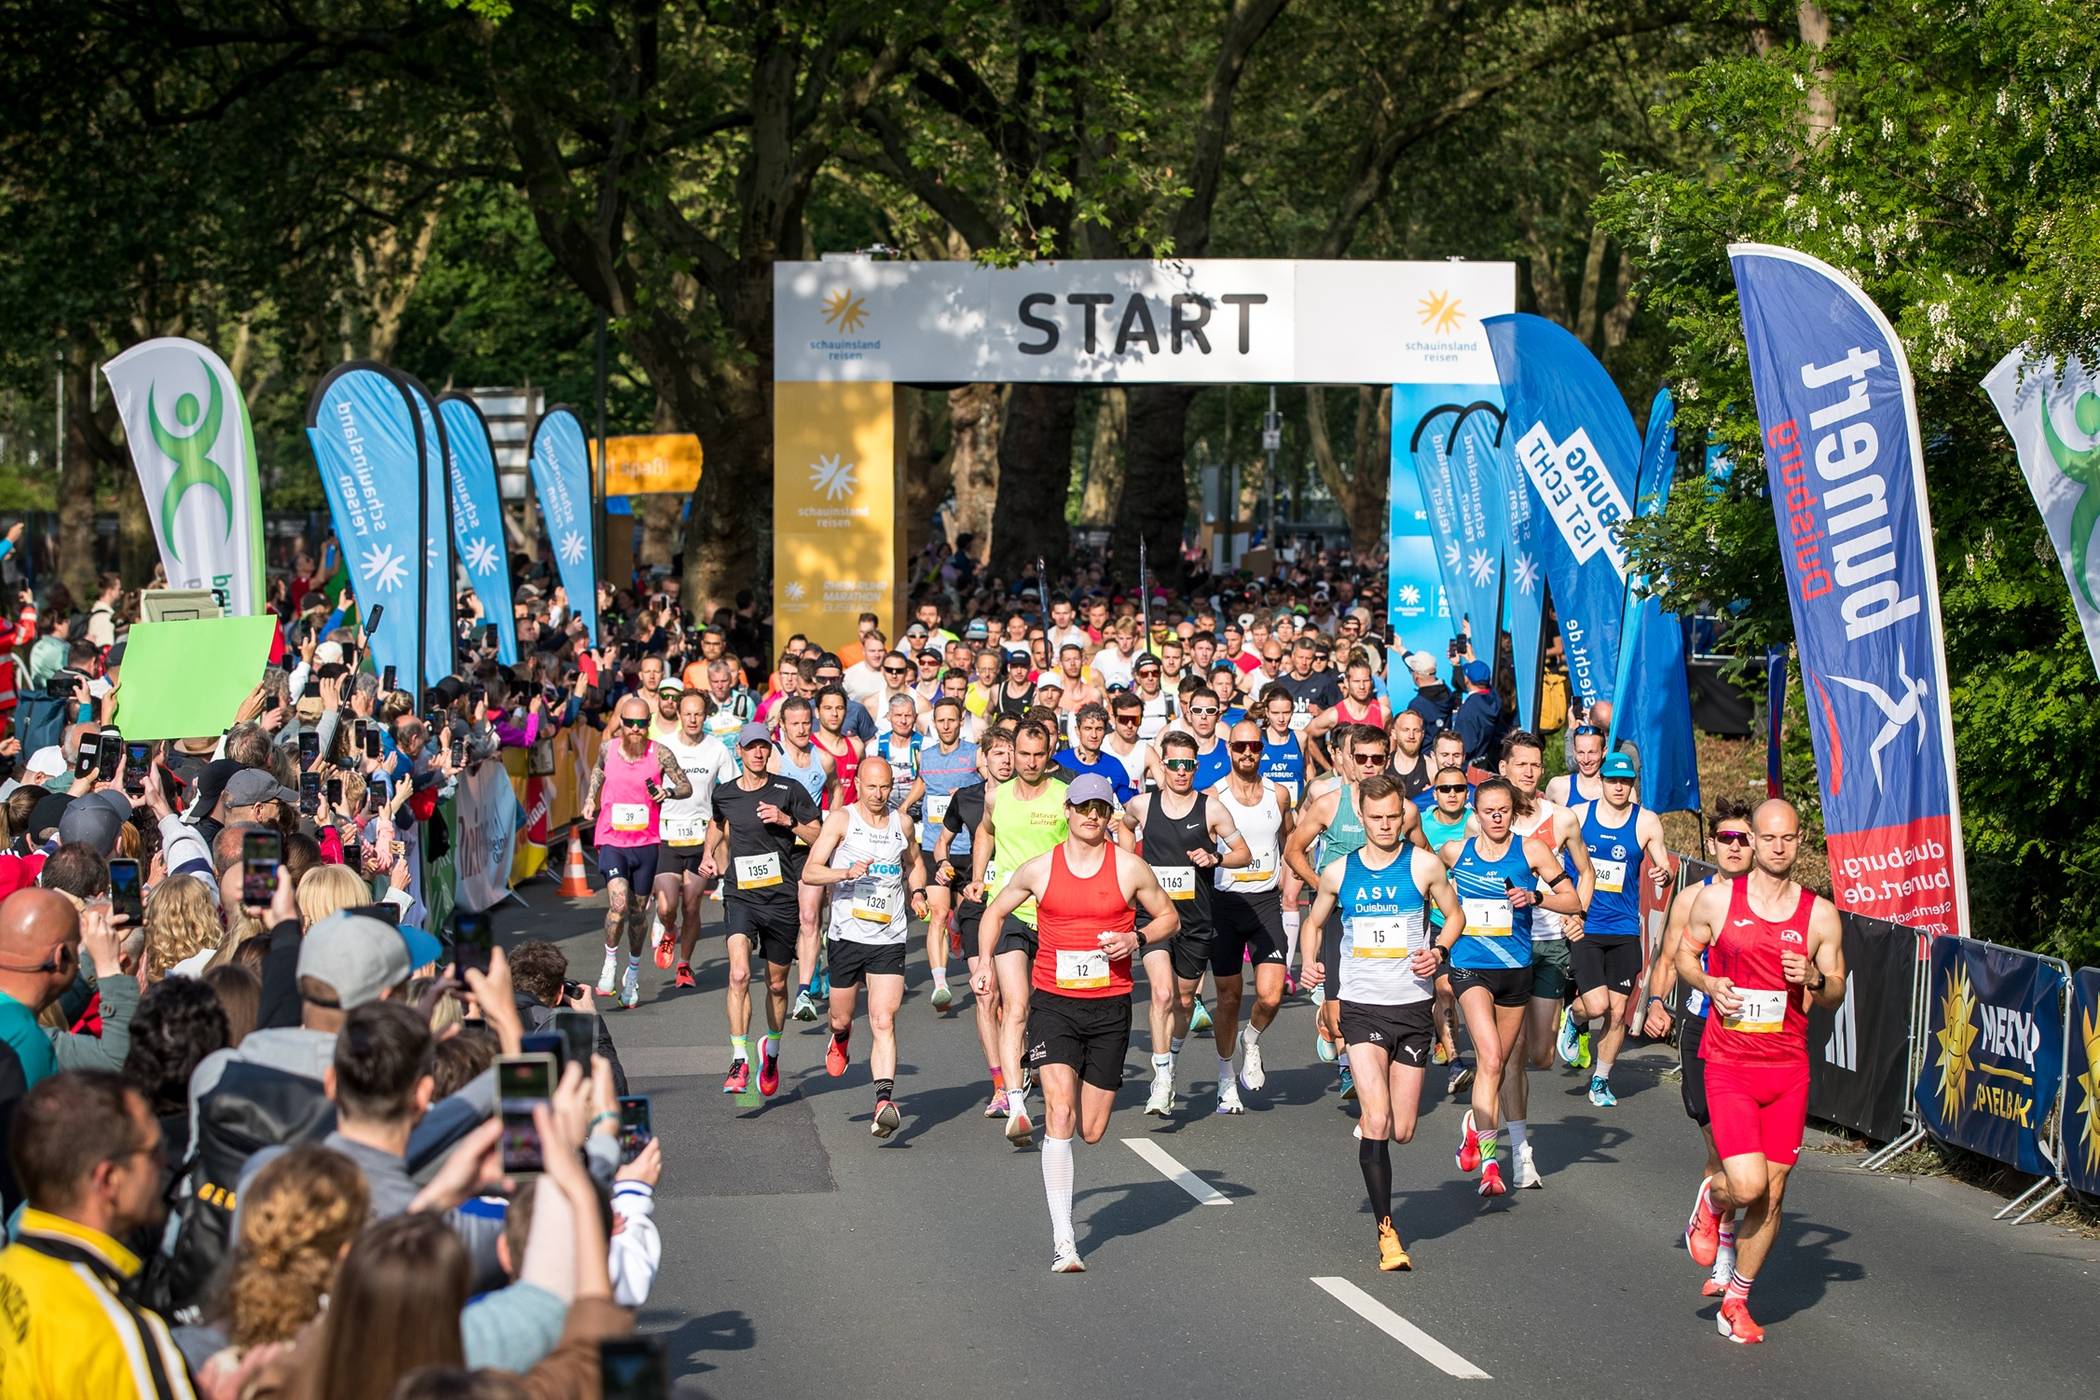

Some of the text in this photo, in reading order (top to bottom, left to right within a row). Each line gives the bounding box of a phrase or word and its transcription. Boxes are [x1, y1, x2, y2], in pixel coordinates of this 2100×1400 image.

[1017, 292, 1268, 356] START
[809, 340, 881, 350] schauinsland
[1405, 341, 1478, 351] schauinsland
[828, 351, 863, 360] reisen
[1424, 353, 1459, 362] reisen
[816, 519, 851, 527] reisen
[1270, 763, 1288, 771] ASV
[625, 813, 634, 821] 39
[748, 864, 769, 877] 1355
[1162, 876, 1183, 888] 1163
[865, 896, 887, 910] 1328
[1355, 903, 1399, 913] Duisburg
[1484, 911, 1489, 923] 1
[1373, 930, 1385, 943] 15
[1076, 964, 1089, 977] 12
[1749, 1003, 1761, 1018] 11
